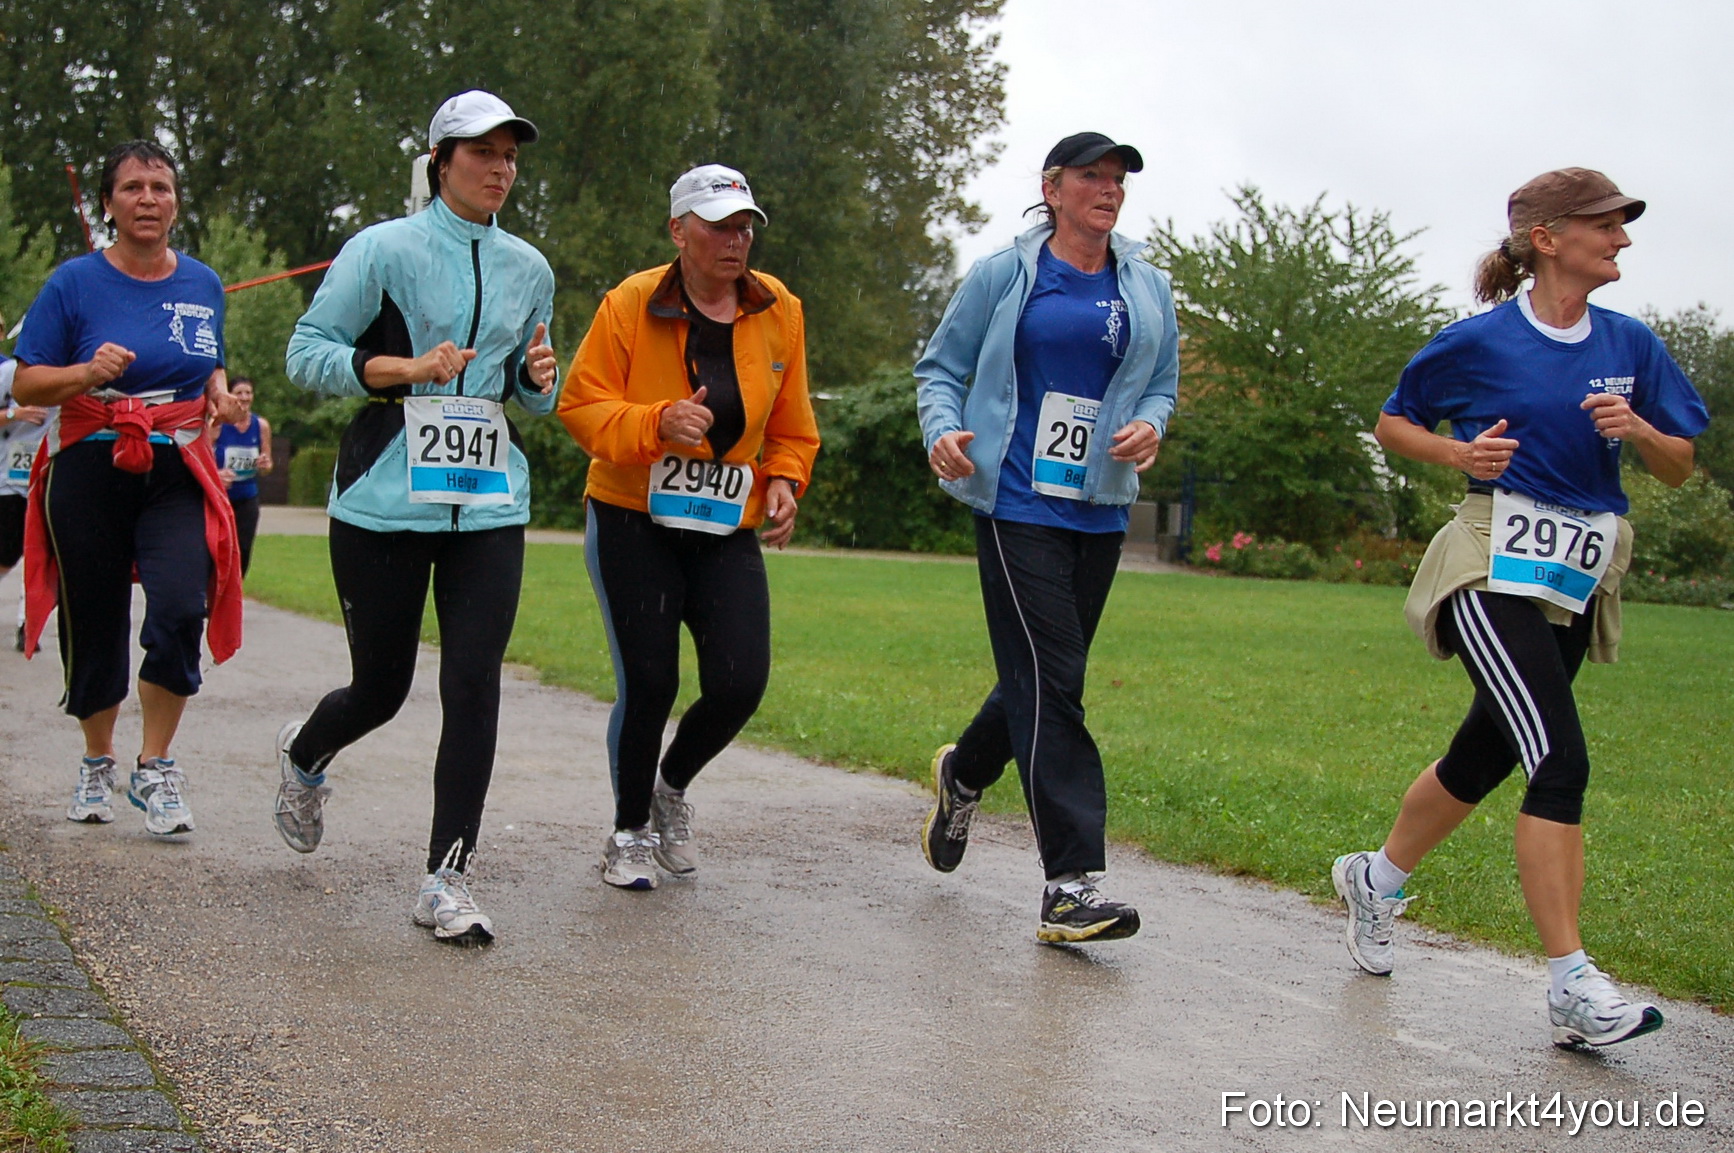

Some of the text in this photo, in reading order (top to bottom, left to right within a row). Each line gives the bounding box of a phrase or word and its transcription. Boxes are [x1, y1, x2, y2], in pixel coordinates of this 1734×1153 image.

[12, 452, 32, 469] 23
[419, 424, 498, 467] 2941
[1046, 421, 1095, 461] 29
[446, 472, 479, 492] Helga
[661, 456, 743, 500] 2940
[684, 501, 713, 517] Jutta
[1505, 514, 1604, 571] 2976
